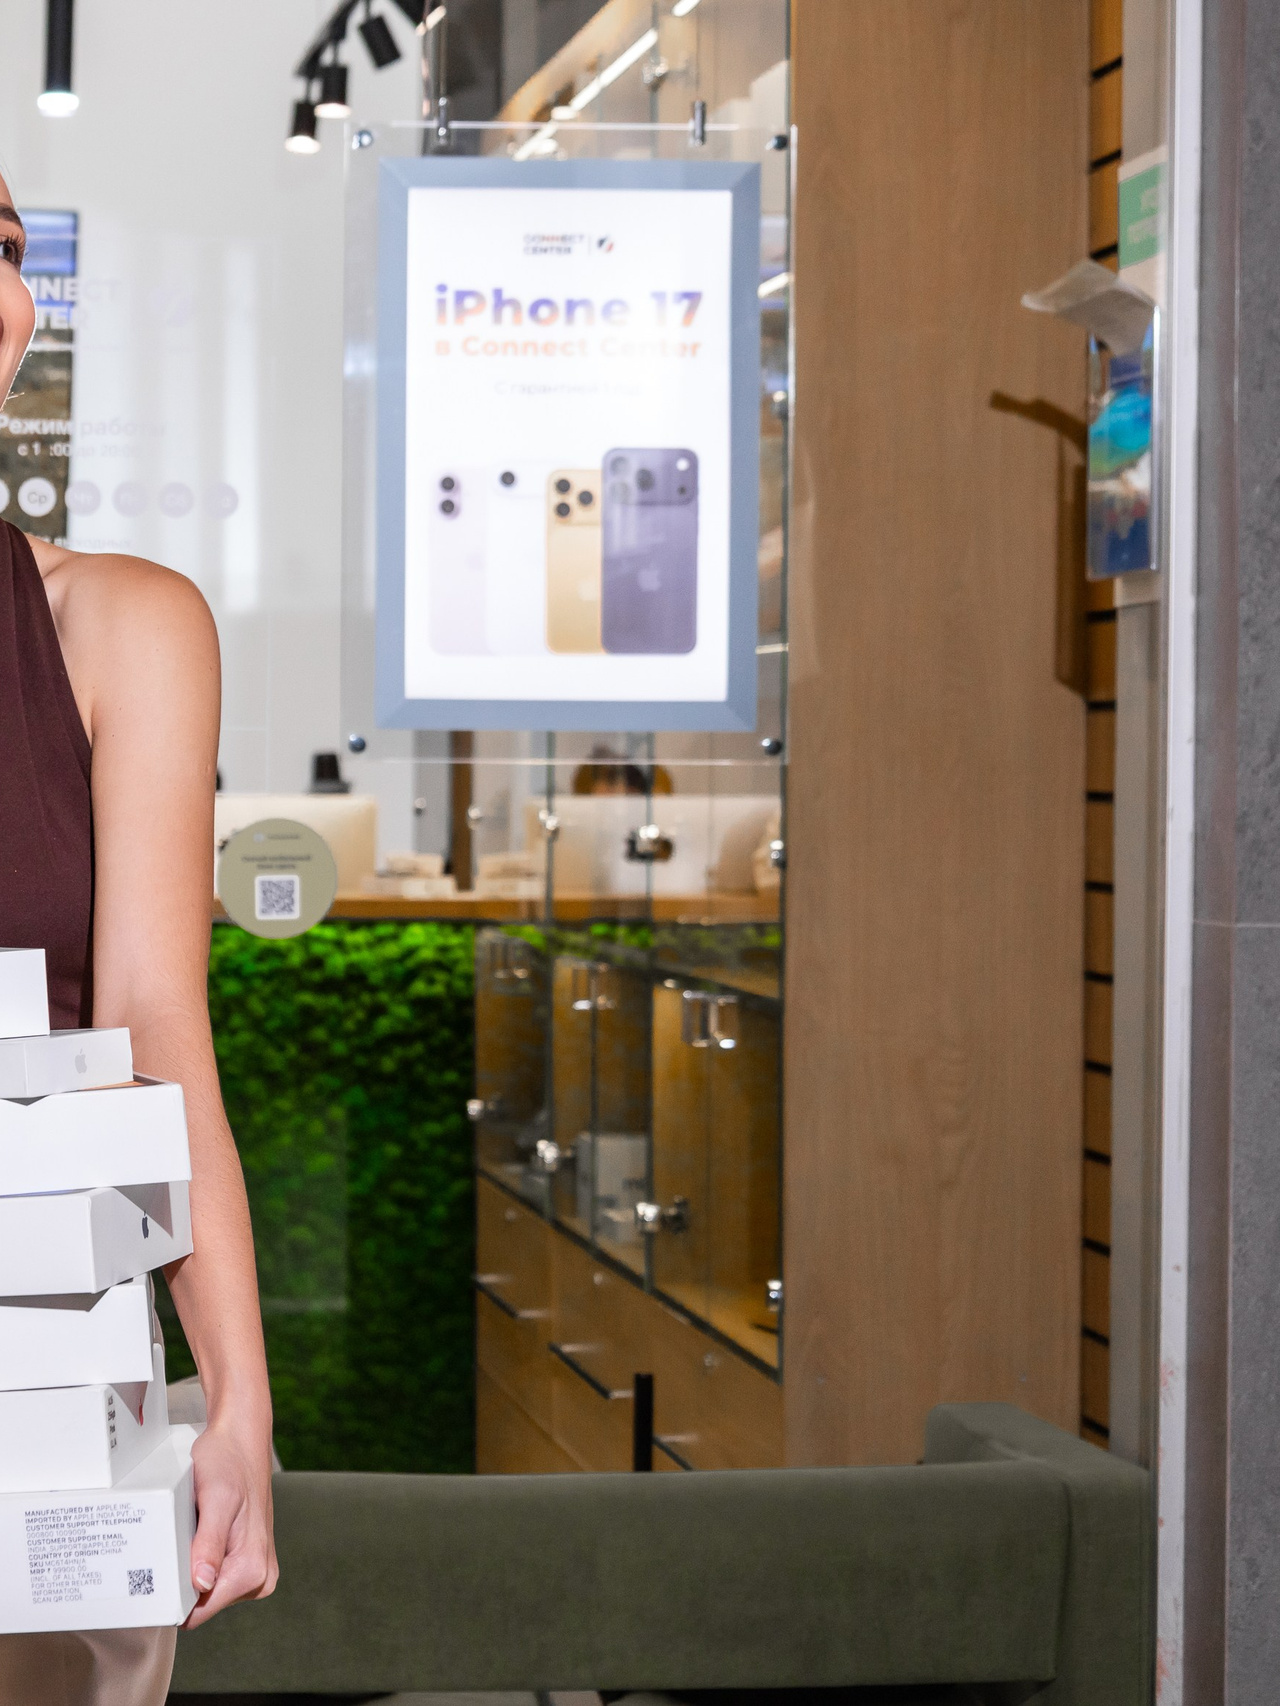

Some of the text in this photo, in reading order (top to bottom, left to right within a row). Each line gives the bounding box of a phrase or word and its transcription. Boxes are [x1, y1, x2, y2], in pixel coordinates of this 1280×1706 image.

[435, 283, 703, 328] iPhone 17
[461, 335, 589, 357] Connect
[599, 336, 702, 359] Center
[27, 491, 47, 506] Ср
[25, 1507, 83, 1516] MANUFACTURED
[96, 1504, 117, 1512] APPLE
[25, 1515, 61, 1524] IMPORTED
[73, 1513, 94, 1521] APPLE
[96, 1511, 114, 1519] INDIA
[26, 1516, 142, 1531] CUSTOMER SUPPORT TELEPHONE
[27, 1537, 66, 1546] CUSTOMER
[68, 1534, 100, 1543] SUPPORT
[28, 1552, 62, 1561] COUNTRY
[74, 1549, 99, 1557] ORIGIN
[100, 1547, 122, 1555] CHINA
[29, 1560, 44, 1568] SKU
[46, 1580, 70, 1589] OTHER
[71, 1578, 102, 1587] RELATED
[32, 1587, 80, 1596] INFORMATION
[32, 1593, 83, 1604] SCAN QR CODE
